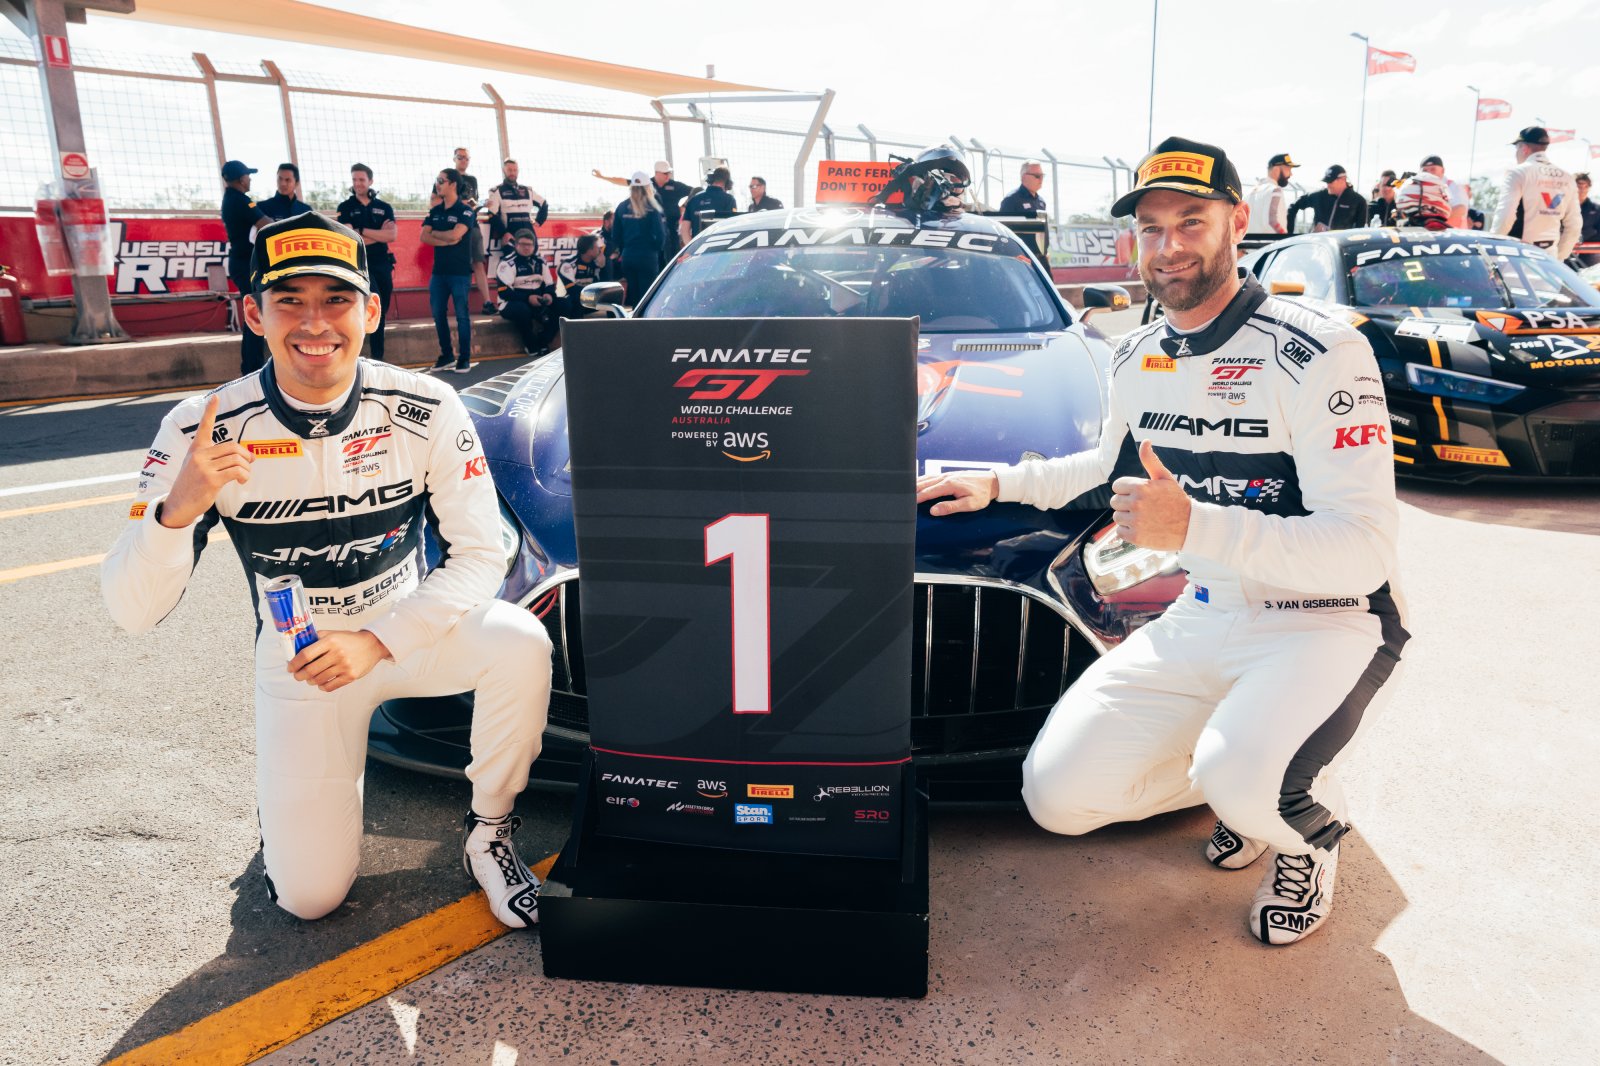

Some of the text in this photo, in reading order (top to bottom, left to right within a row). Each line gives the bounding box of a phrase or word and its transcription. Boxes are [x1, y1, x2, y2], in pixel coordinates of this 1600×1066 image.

[828, 167, 893, 179] PARC FER
[820, 182, 858, 191] DON'T
[274, 234, 352, 258] PIRELLI
[695, 228, 1000, 252] FANATEC
[120, 241, 231, 256] UEENSL
[1356, 243, 1547, 266] FANATEC
[1403, 261, 1426, 282] 2
[1521, 310, 1590, 329] PSA
[1284, 341, 1312, 364] OMP
[1510, 341, 1545, 350] THE
[671, 348, 812, 363] FANATEC
[1146, 357, 1174, 369] PIRELLI
[1211, 357, 1266, 365] FANATEC
[1210, 365, 1264, 380] GT
[672, 369, 811, 401] GT
[1228, 392, 1246, 400] aws
[397, 403, 430, 422] OMP
[680, 405, 793, 416] WORLD CHALLENGE
[671, 416, 731, 425] AUSTRALIA
[1168, 412, 1269, 438] AMG
[211, 428, 229, 443] MP
[341, 425, 392, 443] FANATEC
[671, 431, 719, 439] POWERED
[723, 431, 769, 448] aws
[1332, 423, 1388, 450] KFC
[342, 433, 393, 457] GT
[705, 440, 718, 448] BY
[361, 463, 380, 473] aws
[290, 478, 413, 517] AMG
[362, 562, 411, 599] EIGHT
[308, 594, 357, 607] IPLE
[1264, 598, 1360, 610] S. VAN GISBERGEN
[703, 512, 772, 715] 1
[601, 773, 679, 790] FANATEC
[697, 779, 727, 791] aws
[750, 786, 790, 797] PIRELLI
[827, 785, 890, 794] REBELLION
[854, 809, 890, 820] SRO
